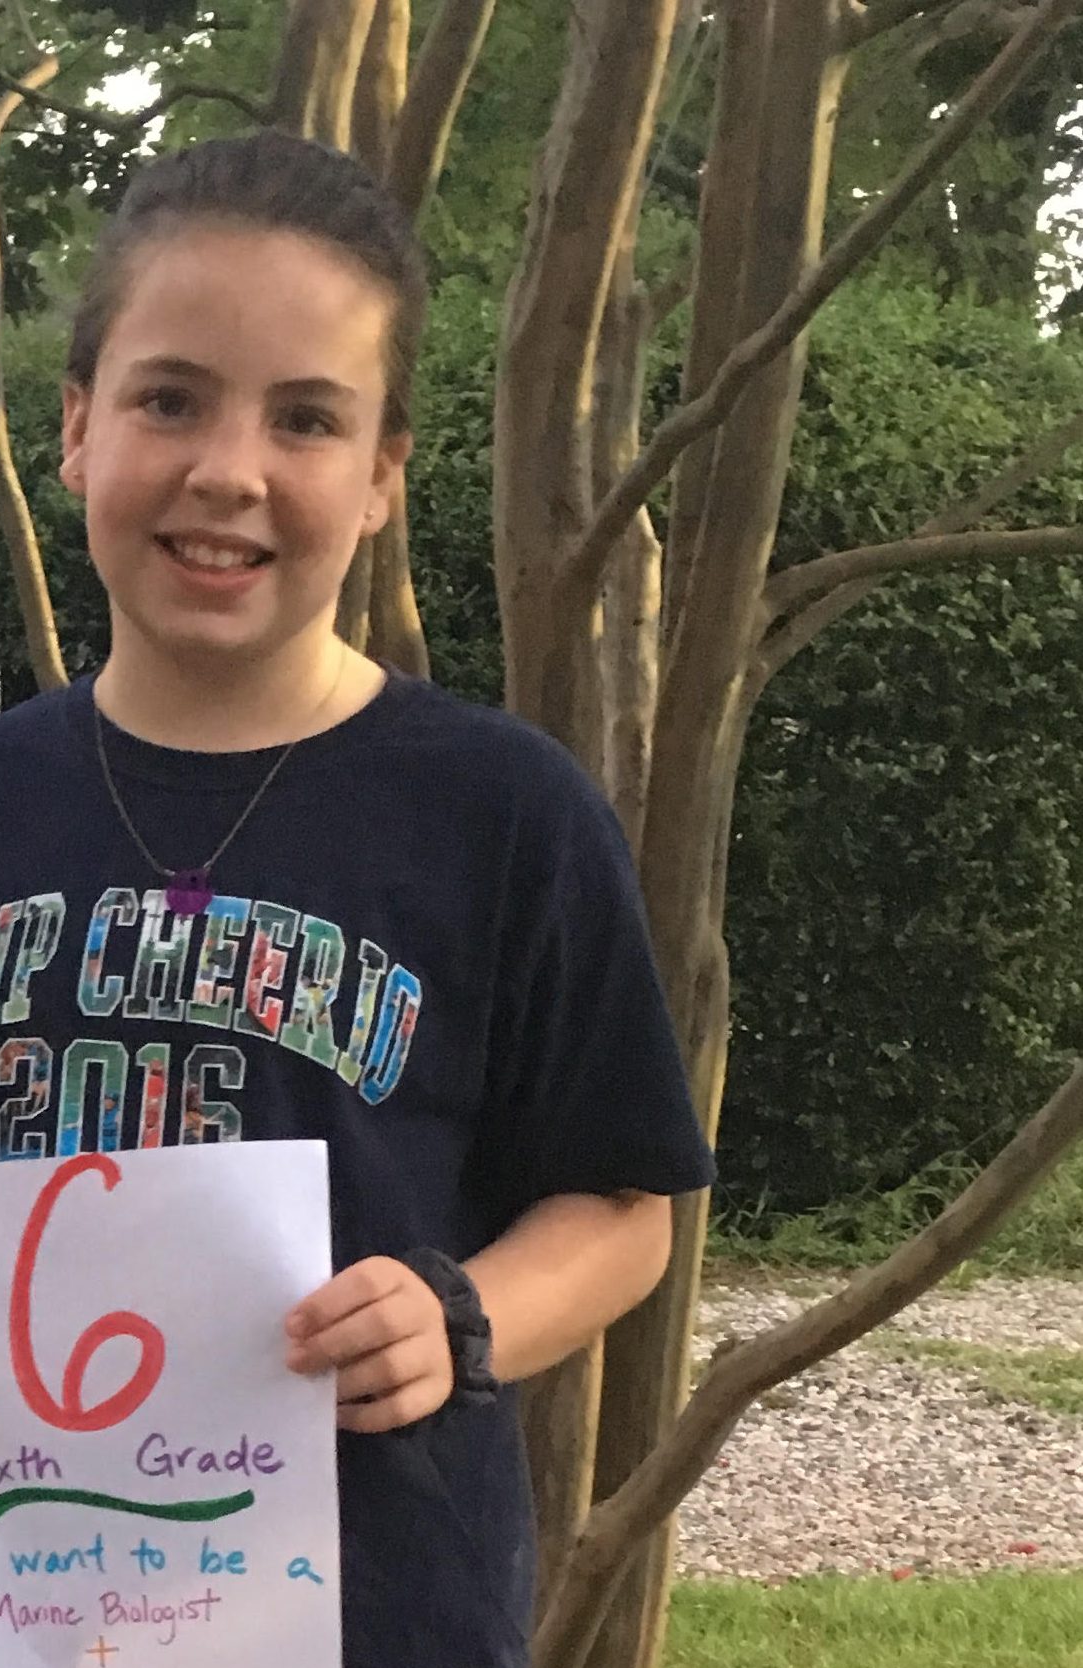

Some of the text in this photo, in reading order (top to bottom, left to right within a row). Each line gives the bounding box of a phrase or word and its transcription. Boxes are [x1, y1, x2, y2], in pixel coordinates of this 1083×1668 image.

[8, 1150, 166, 1432] 6
[136, 1433, 285, 1476] Grade
[9, 1537, 106, 1576] want
[129, 1536, 167, 1576] to
[200, 1536, 247, 1576] be
[286, 1556, 324, 1585] a
[98, 1586, 222, 1645] Biologist
